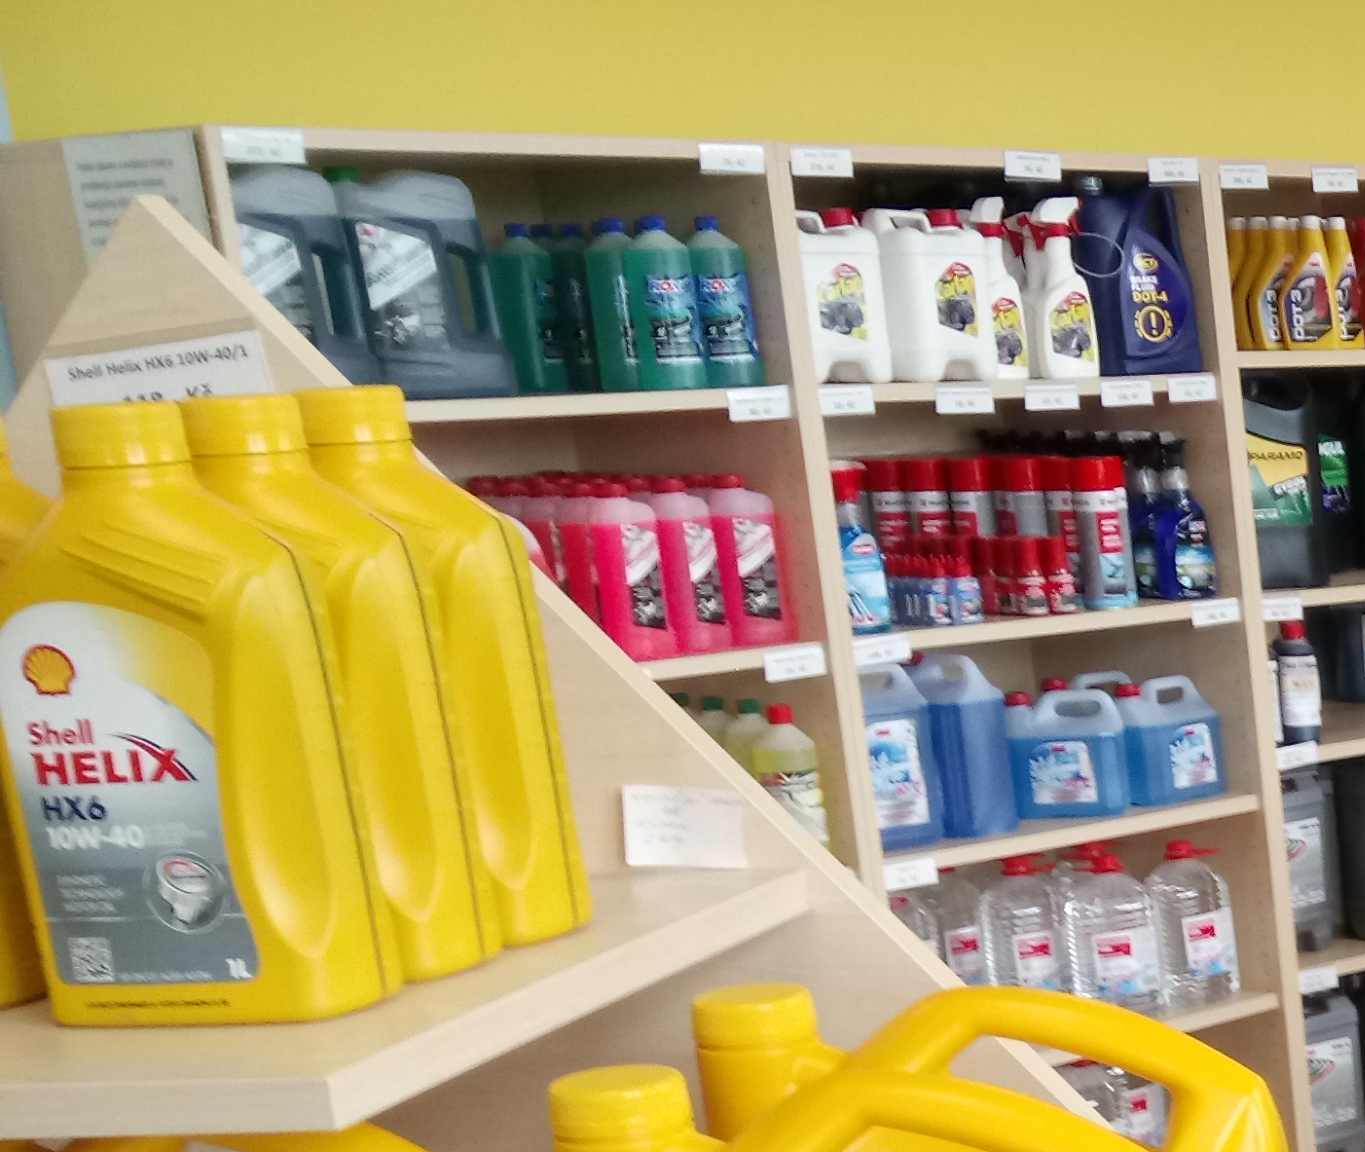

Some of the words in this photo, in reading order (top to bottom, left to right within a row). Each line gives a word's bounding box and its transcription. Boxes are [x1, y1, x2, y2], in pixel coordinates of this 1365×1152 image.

[28, 717, 94, 746] Shell
[30, 748, 196, 786] HELIX
[41, 795, 108, 822] HX6
[46, 823, 145, 849] 10W-40
